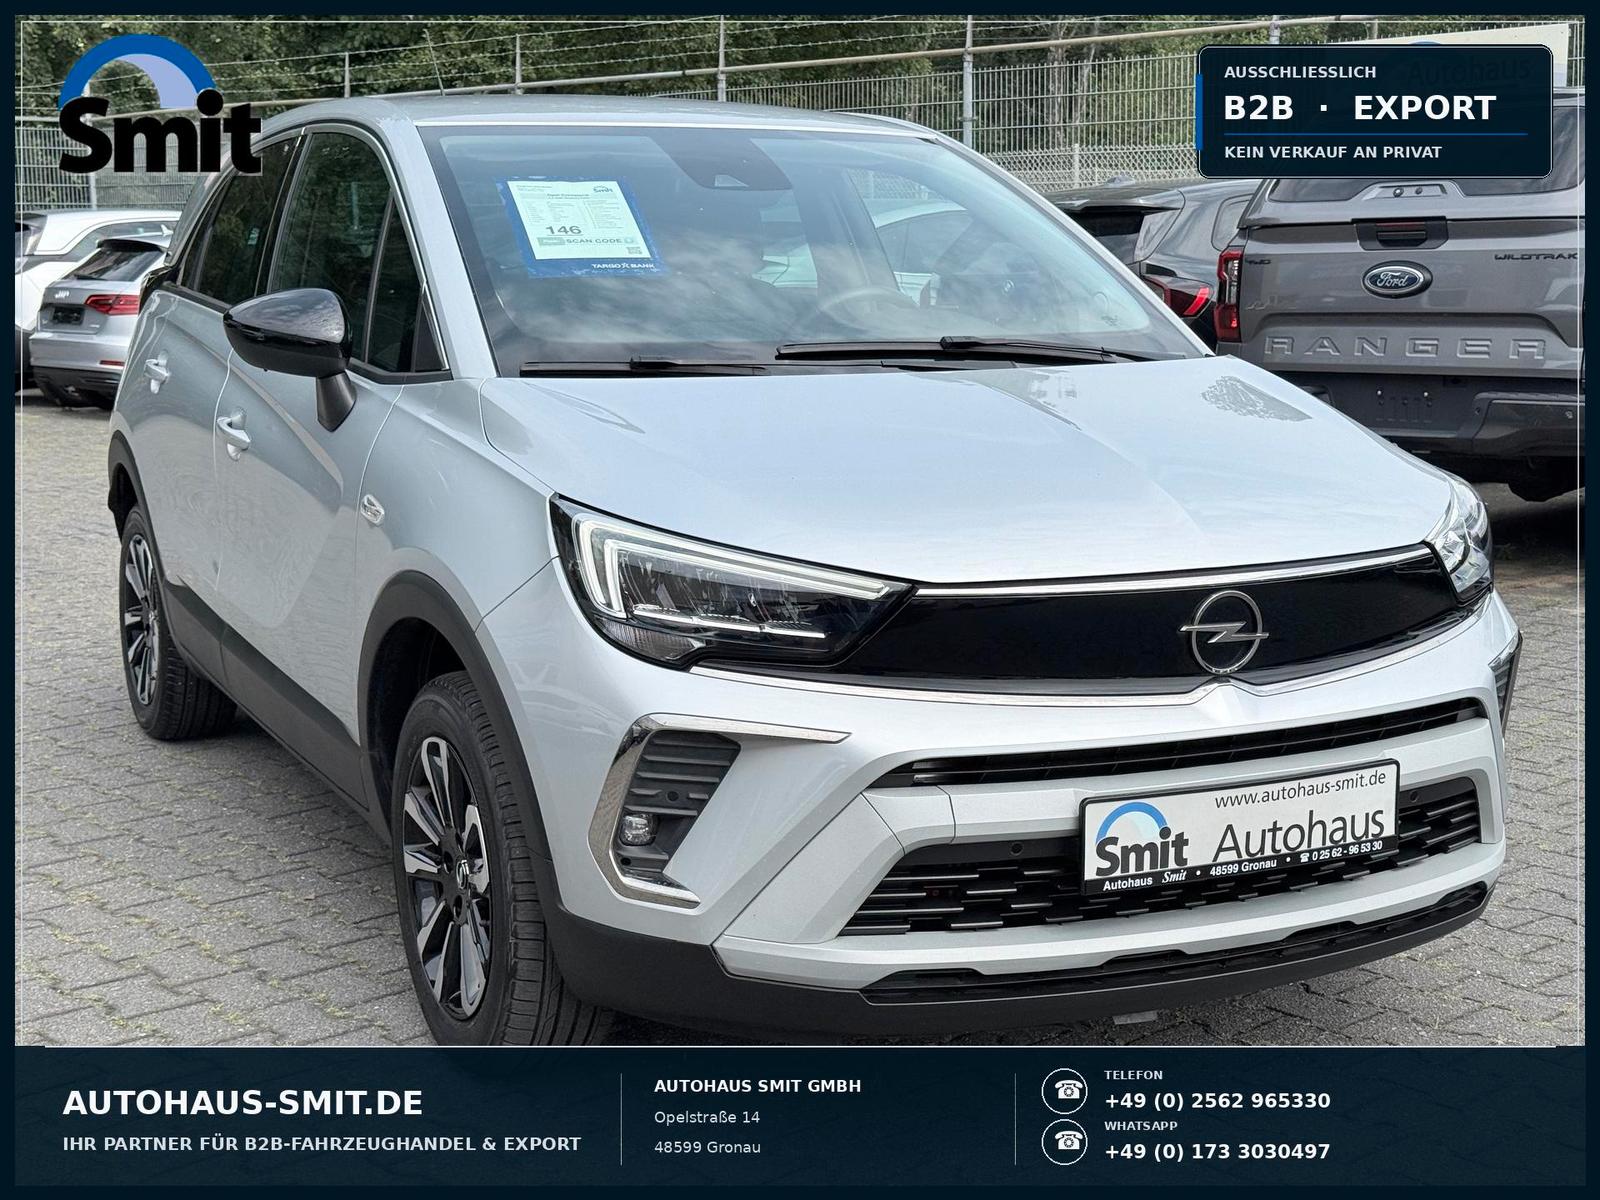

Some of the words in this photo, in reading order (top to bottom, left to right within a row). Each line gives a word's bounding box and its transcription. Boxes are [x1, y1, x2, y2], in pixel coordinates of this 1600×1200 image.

[545, 225, 582, 235] 146
[1494, 252, 1578, 261] WILDTRAK
[1376, 271, 1408, 288] Ford
[1264, 336, 1546, 360] RANGER
[1215, 769, 1386, 809] www.autohaus-smit.de
[1095, 826, 1189, 877] Smit
[1212, 809, 1385, 863] Autohaus
[1102, 876, 1153, 891] Autohaus
[1161, 868, 1188, 883] Smit
[1209, 864, 1239, 877] 48599
[1241, 858, 1278, 873] Gronau
